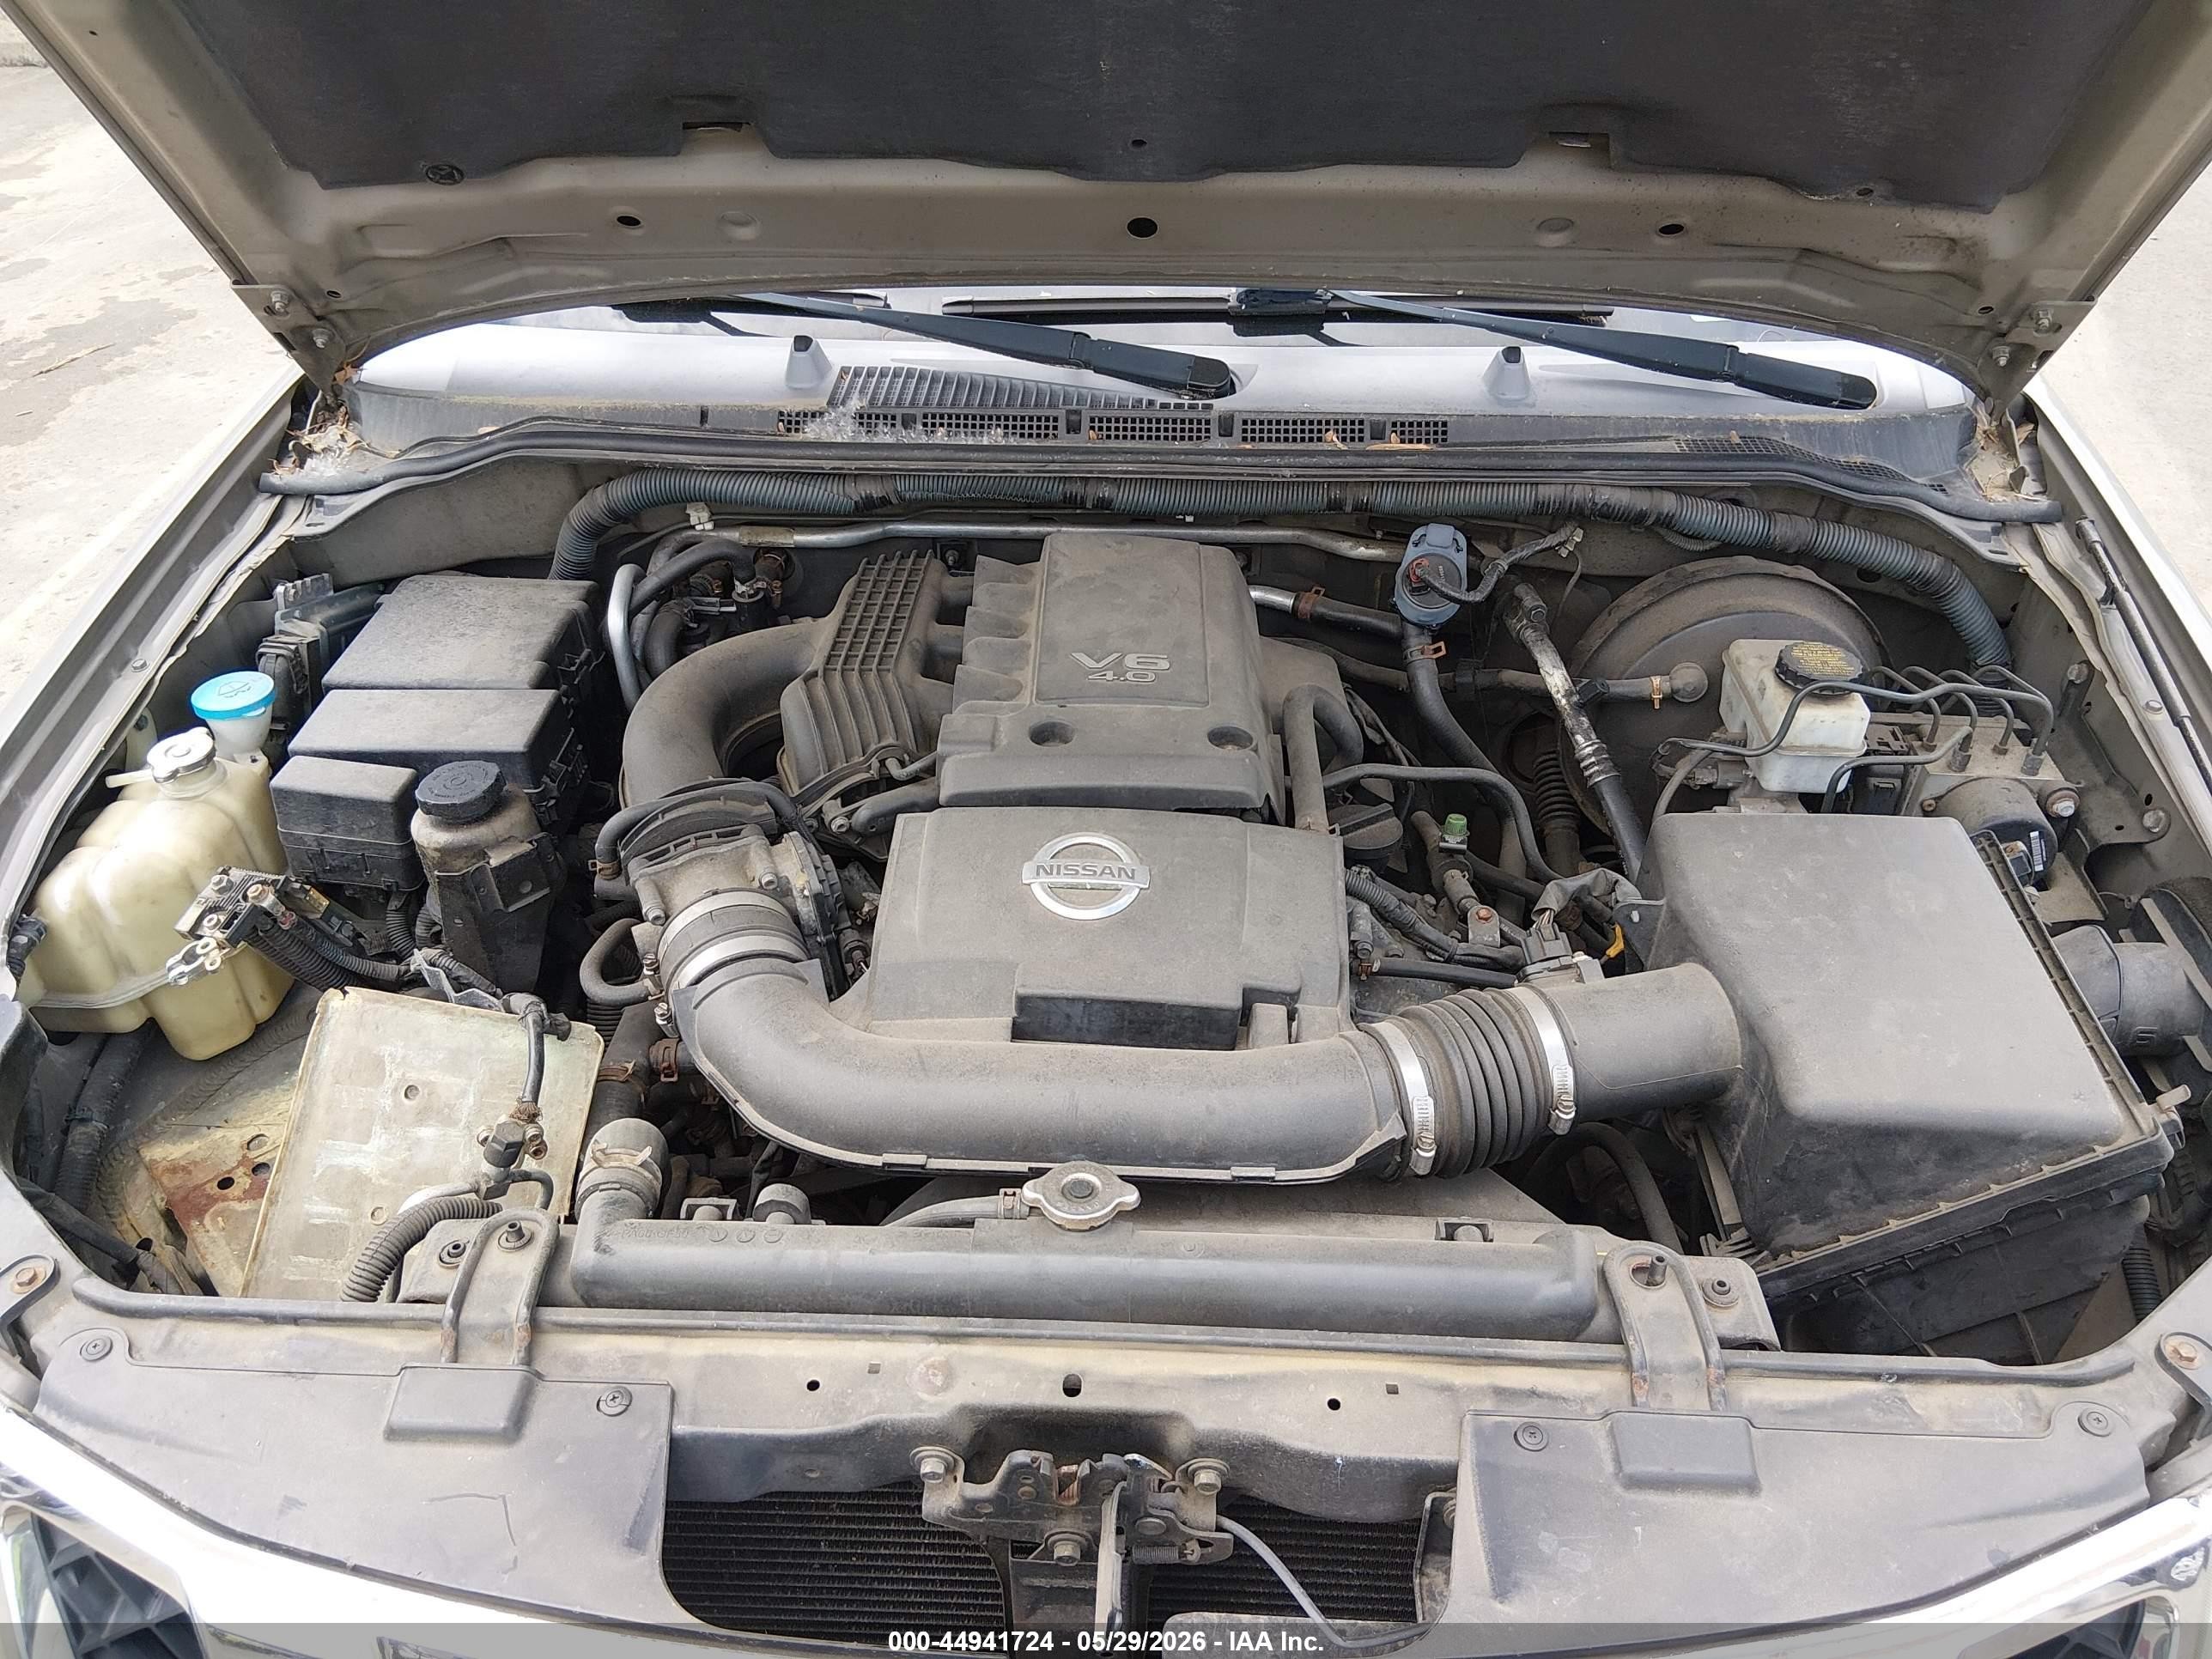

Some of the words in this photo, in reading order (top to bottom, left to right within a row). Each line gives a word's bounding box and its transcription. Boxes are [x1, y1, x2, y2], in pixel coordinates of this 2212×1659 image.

[1070, 652, 1170, 671] V6
[1087, 670, 1156, 684] 4.0
[1036, 863, 1136, 880] NISSAN
